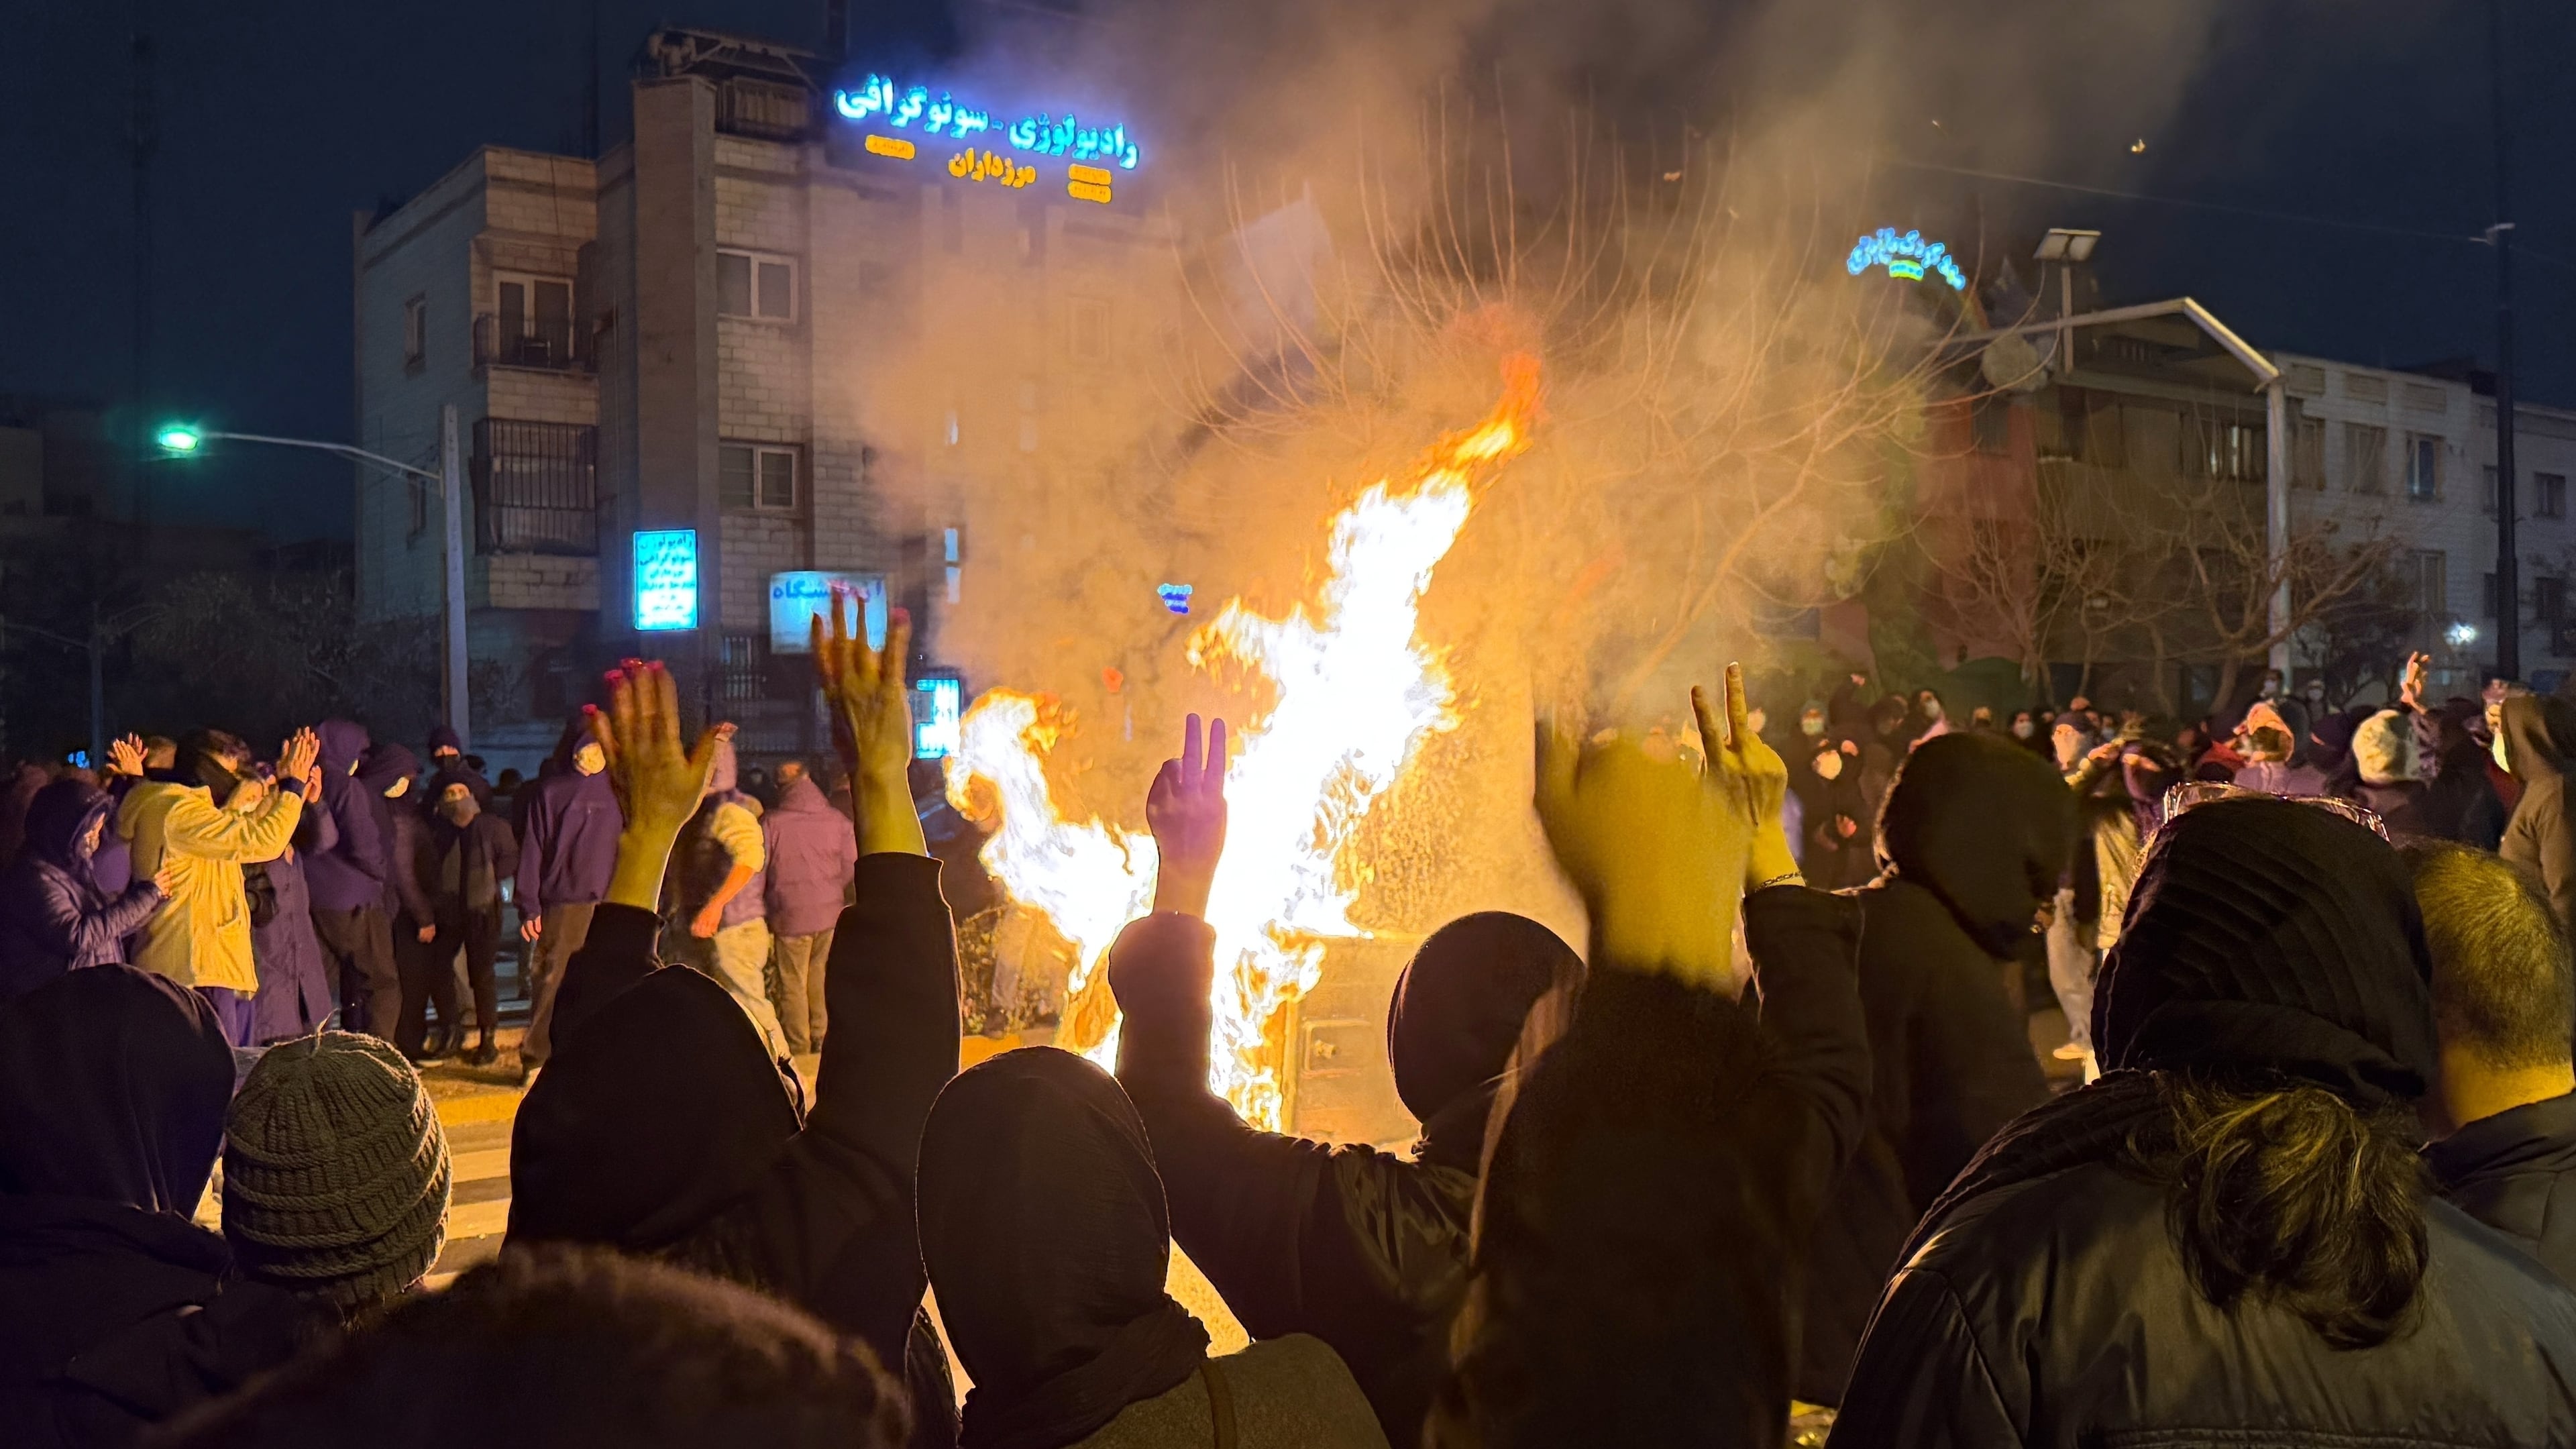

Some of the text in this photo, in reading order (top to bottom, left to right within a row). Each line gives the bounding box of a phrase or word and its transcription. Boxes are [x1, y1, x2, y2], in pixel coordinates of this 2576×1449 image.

[835, 74, 989, 139] سونوگرافی
[948, 147, 1036, 188] مرزداران
[1009, 113, 1138, 169] رادیولوژی
